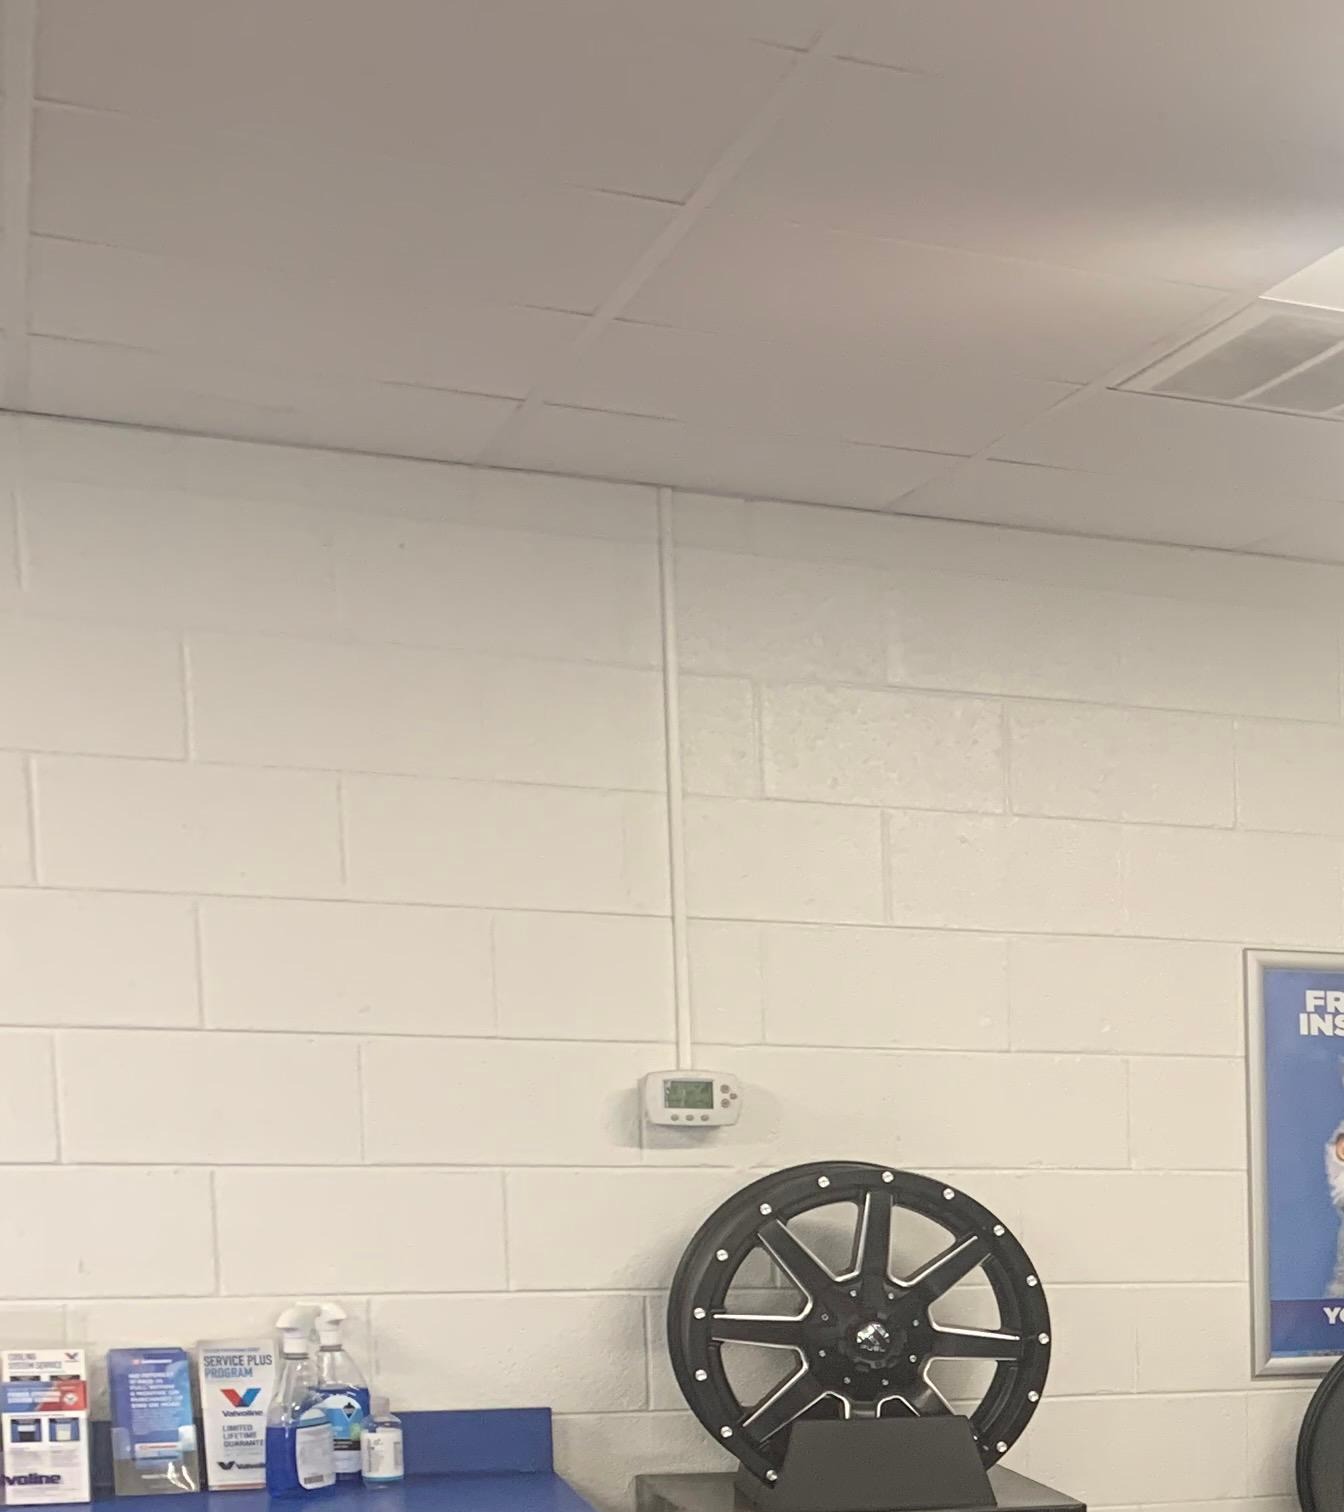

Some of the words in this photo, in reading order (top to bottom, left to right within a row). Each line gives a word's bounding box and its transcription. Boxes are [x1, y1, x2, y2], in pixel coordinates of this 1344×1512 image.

[203, 1355, 244, 1367] SERVICE
[248, 1354, 273, 1366] PLUS
[204, 1367, 253, 1378] PROGRAM
